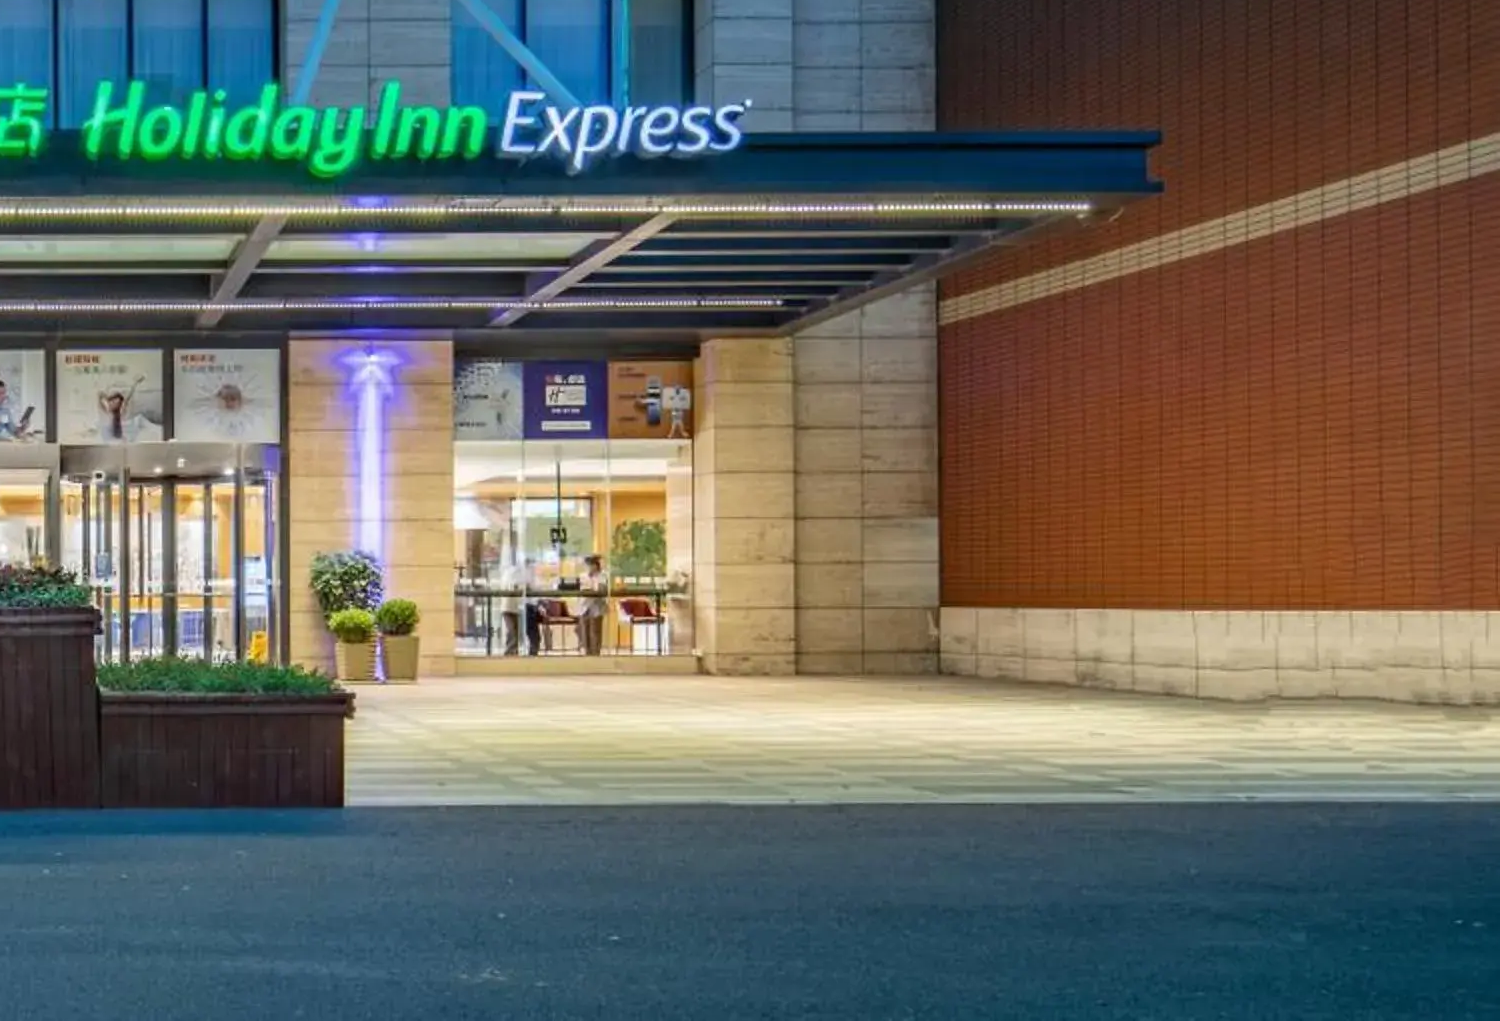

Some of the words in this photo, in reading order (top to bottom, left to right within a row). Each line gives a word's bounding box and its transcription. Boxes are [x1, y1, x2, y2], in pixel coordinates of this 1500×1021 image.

[85, 81, 361, 176] Holiday
[368, 81, 486, 157] Inn
[500, 90, 745, 174] Express
